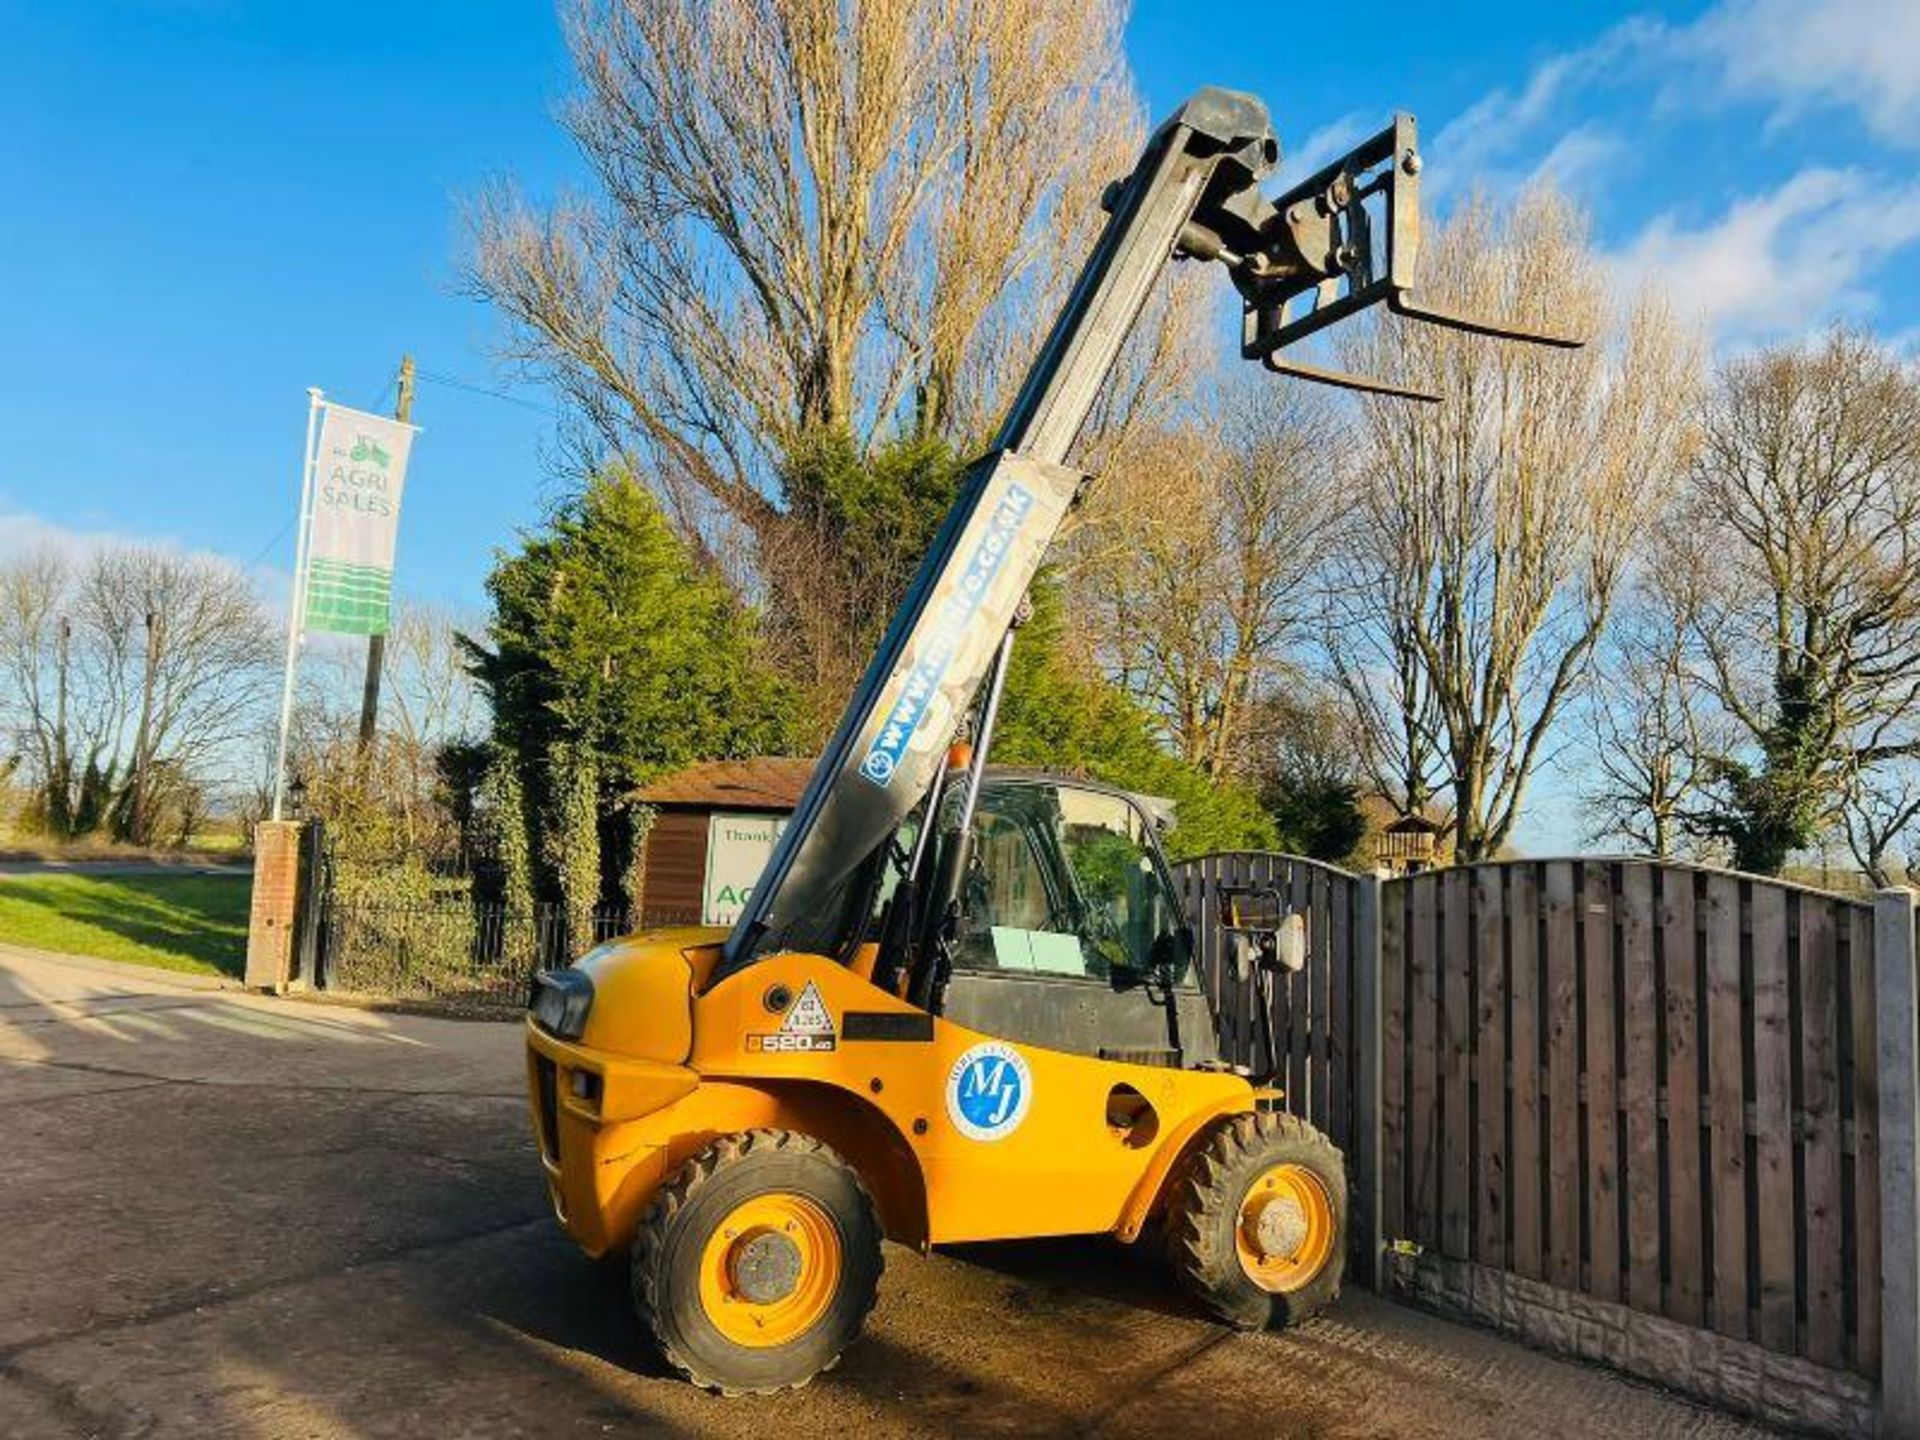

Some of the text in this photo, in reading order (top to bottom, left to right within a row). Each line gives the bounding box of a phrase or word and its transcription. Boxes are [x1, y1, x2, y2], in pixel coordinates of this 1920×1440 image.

[331, 465, 388, 491] AGRI
[322, 486, 391, 517] SALES
[725, 829, 771, 843] Thank
